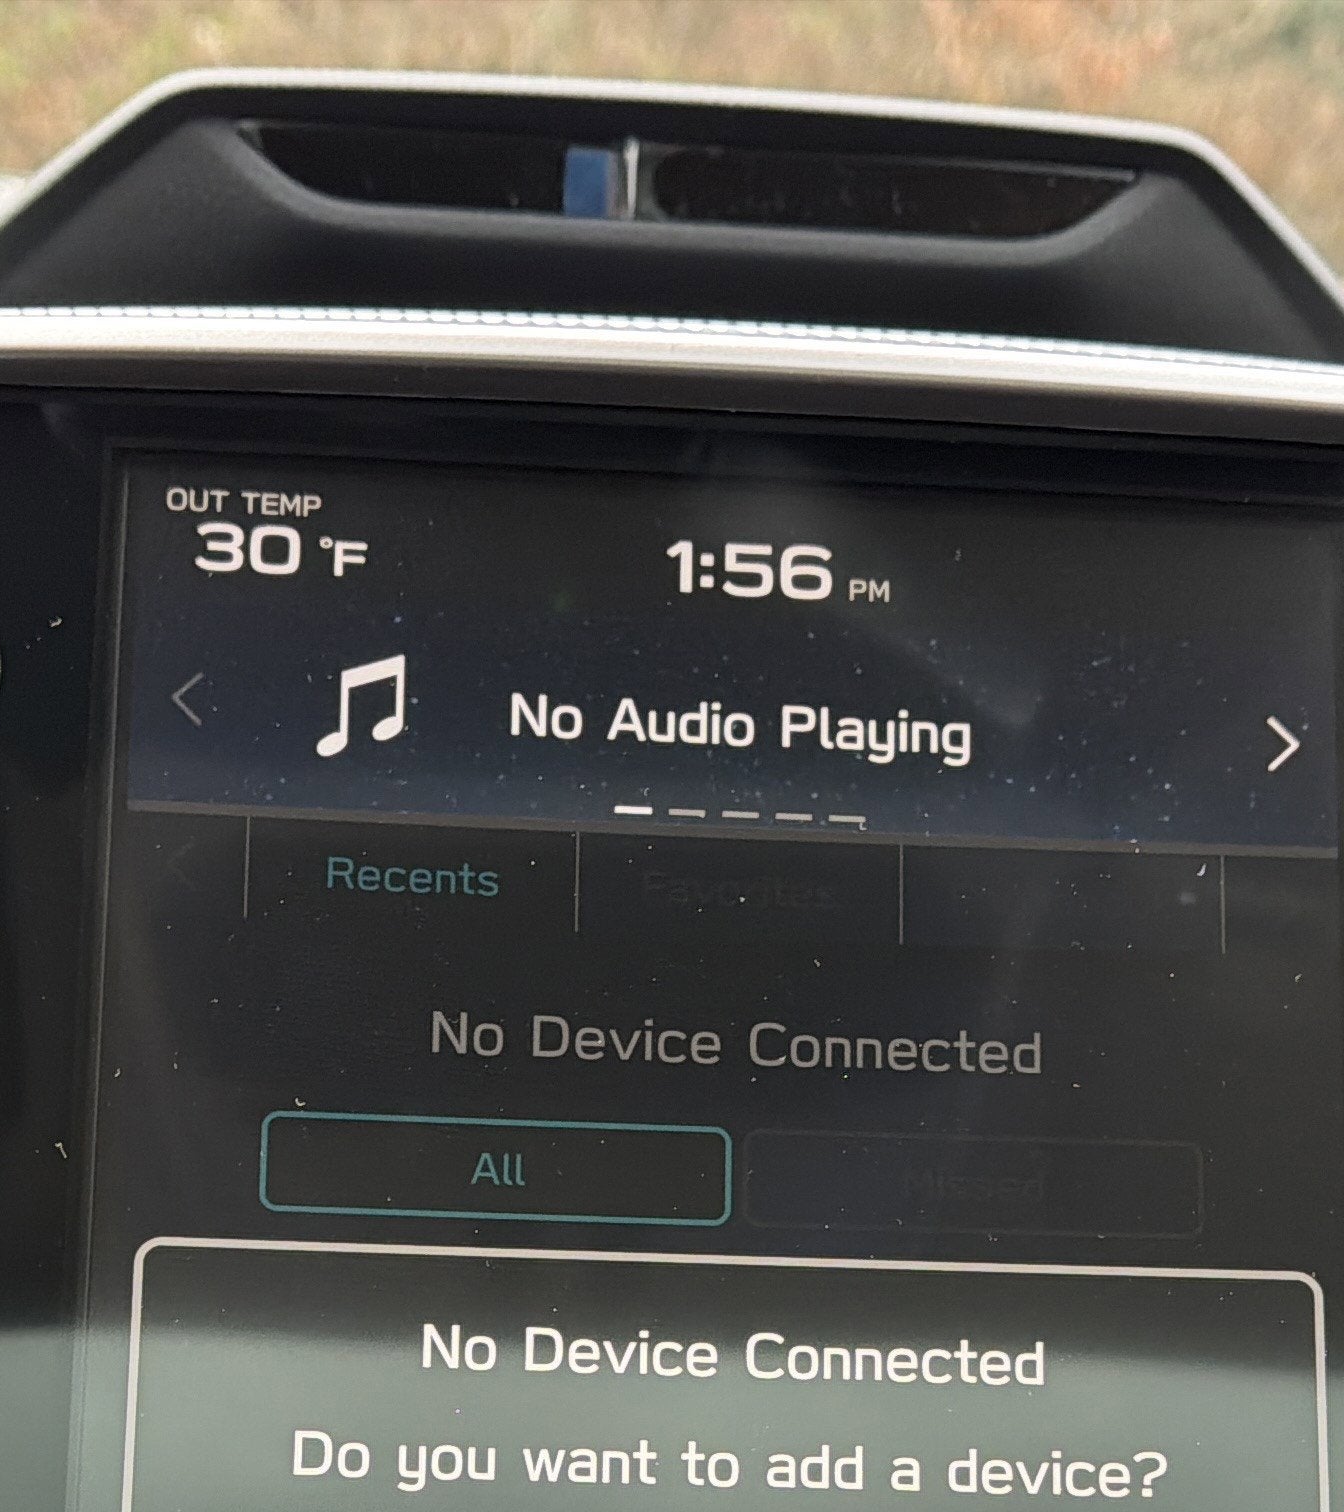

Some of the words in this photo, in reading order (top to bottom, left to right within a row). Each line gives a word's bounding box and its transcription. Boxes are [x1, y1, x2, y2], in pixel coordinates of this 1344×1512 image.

[166, 487, 230, 513] OUT
[240, 491, 322, 518] TEMP
[195, 522, 301, 575] 30
[666, 540, 833, 601] 1:56
[848, 578, 890, 603] PM
[510, 692, 583, 740] No
[606, 697, 755, 747] Audio
[781, 704, 976, 766] Playing
[326, 856, 499, 897] Recents
[431, 1010, 504, 1057] No
[532, 1014, 721, 1065] Device
[749, 1022, 1042, 1074] Connected
[470, 1152, 526, 1187] All
[421, 1323, 497, 1371] No
[524, 1326, 718, 1378] Device
[745, 1332, 1046, 1386] Connected
[292, 1430, 370, 1479] Do
[397, 1444, 496, 1493] you
[522, 1438, 658, 1486] want
[680, 1440, 740, 1489] to
[766, 1444, 864, 1491] add
[890, 1457, 921, 1492] a
[948, 1448, 1168, 1499] device?
